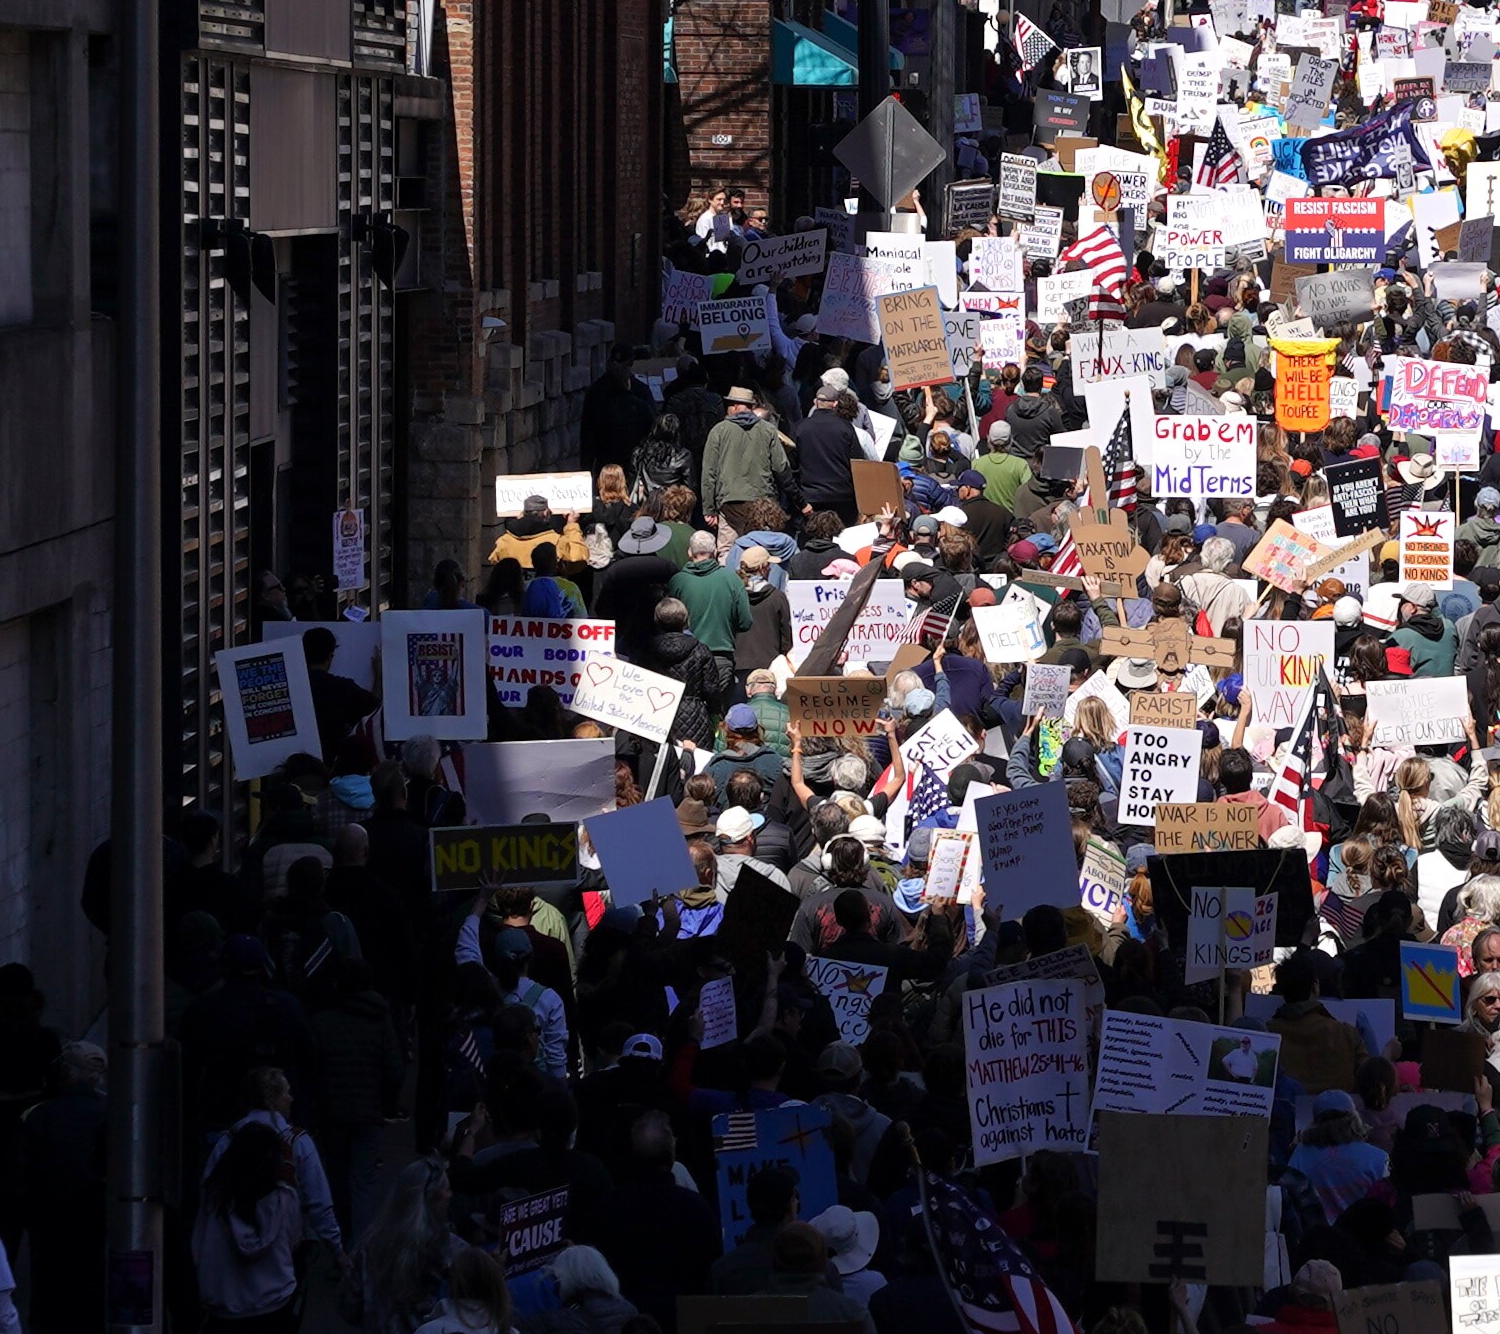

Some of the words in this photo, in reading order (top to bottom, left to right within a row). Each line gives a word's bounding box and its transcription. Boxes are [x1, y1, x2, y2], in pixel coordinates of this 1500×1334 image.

[1293, 201, 1331, 214] RESIST
[1333, 201, 1377, 214] FASCISM
[1168, 230, 1223, 245] POWER
[1167, 253, 1223, 268] PEOPLE
[1293, 247, 1323, 260] FIGHT
[1325, 246, 1377, 261] OLIGARCHY
[699, 296, 764, 313] IMMIGRANTS
[883, 294, 931, 312] BRING
[700, 306, 766, 325] BELONG
[885, 319, 904, 333] ON
[911, 316, 935, 332] THE
[887, 336, 947, 361] MATRIARCHY
[1288, 357, 1320, 367] THERE
[1284, 371, 1309, 383] WILL
[1312, 370, 1323, 382] BE
[1284, 383, 1325, 401] HELL
[1280, 402, 1319, 419] TOUPÉE
[1077, 542, 1130, 557] TAXATION
[1405, 555, 1415, 565] NO
[1417, 555, 1449, 566] CROWNS
[1404, 568, 1419, 581] NO
[1420, 567, 1449, 581] KINGS
[491, 617, 561, 638] HANDS
[570, 620, 615, 639] OFF
[417, 641, 455, 658] RESIST
[799, 693, 868, 709] REGIME
[1136, 696, 1195, 716] RAPIST
[812, 719, 876, 735] NOW
[1133, 714, 1192, 728] PEDOPHILE
[1132, 732, 1168, 748] TOO
[1130, 750, 1191, 767] ANGRY
[1131, 768, 1153, 782] TO
[1128, 785, 1175, 801] STAY
[1157, 805, 1198, 826] WAR
[1204, 807, 1217, 825] IS
[1226, 806, 1255, 825] NOT
[1157, 830, 1185, 849] THE
[1191, 829, 1258, 850] ANSWER
[434, 843, 483, 876] NO
[490, 831, 577, 872] KINGS
